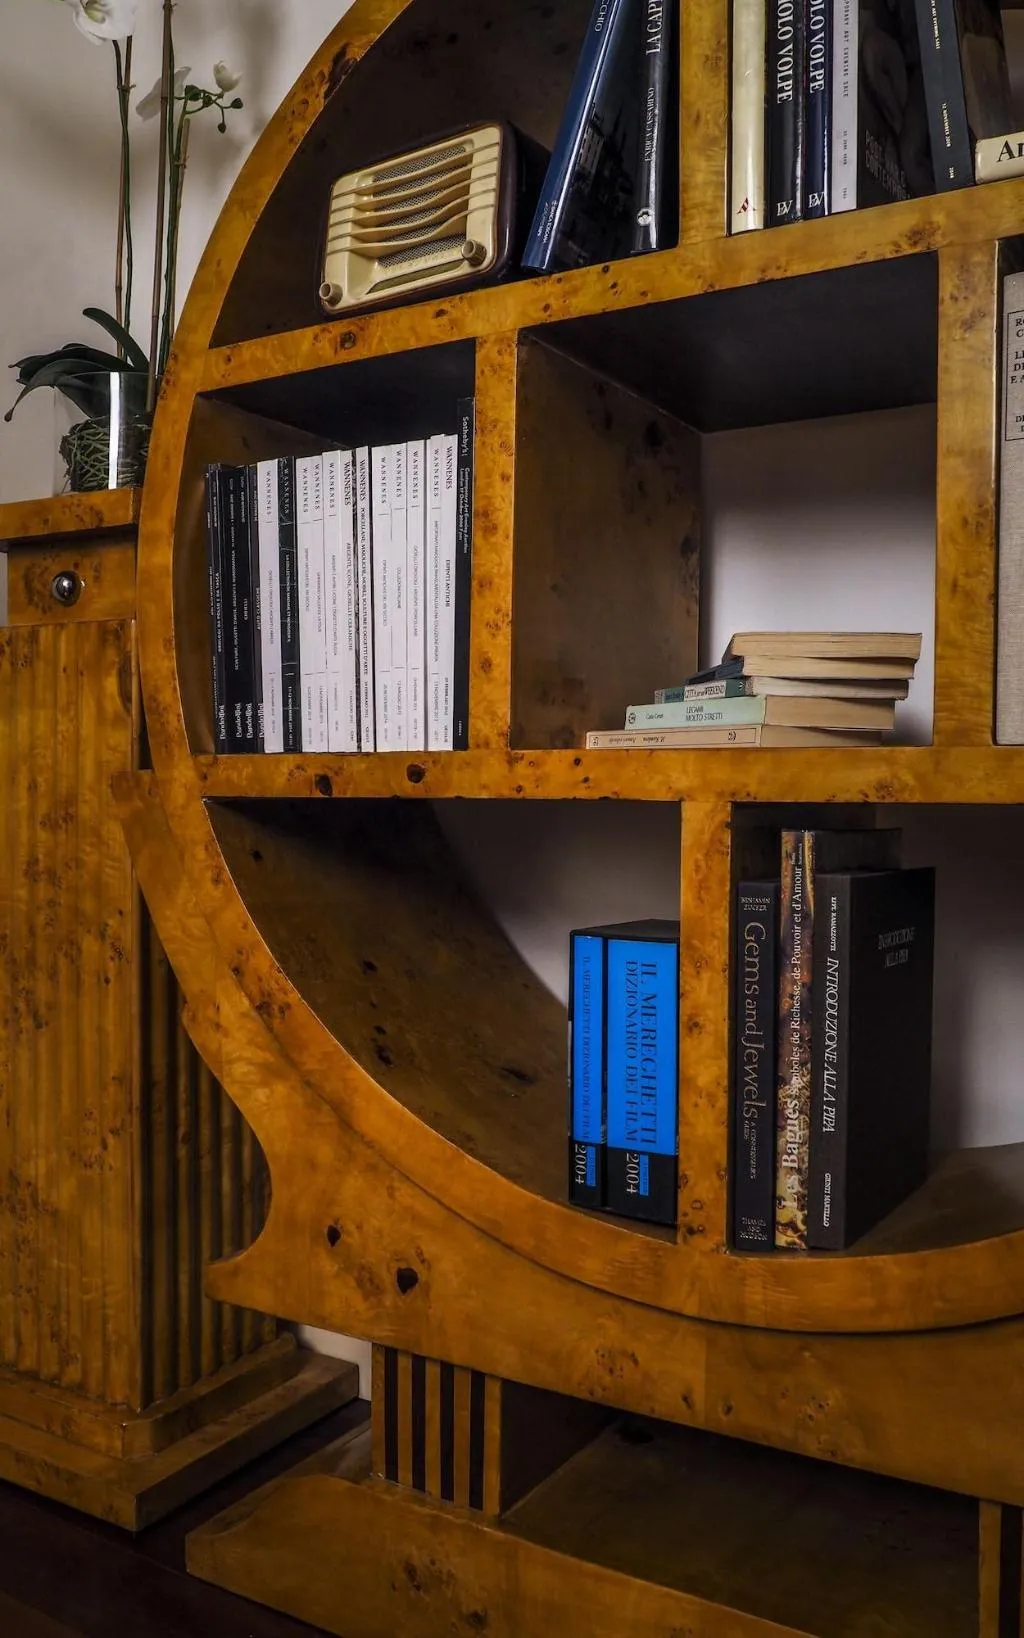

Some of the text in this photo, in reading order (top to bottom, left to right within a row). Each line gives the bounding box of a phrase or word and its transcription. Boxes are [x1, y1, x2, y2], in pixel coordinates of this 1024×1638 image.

[645, 35, 662, 55] LA
[809, 31, 825, 94] VOLPE
[776, 43, 793, 104] VOLPE
[461, 416, 470, 453] Sotheby's
[344, 461, 352, 506] WANNENES
[445, 445, 453, 490] WANNENES
[217, 704, 226, 740] Pandolfini
[233, 702, 243, 738] Pandolfini
[245, 702, 253, 739] Pandolfini
[790, 866, 803, 911] d'Amour
[792, 912, 802, 923] et
[790, 925, 802, 965] Pouvoir
[640, 961, 658, 984] IL
[790, 967, 801, 980] de
[741, 921, 767, 1119] Gems and Jewels
[790, 981, 803, 1030] Richesse,
[624, 959, 638, 1142] DIZIONARIO DEI FILM
[790, 1031, 801, 1045] de
[822, 957, 839, 1133] INTRODUZIONE ALLA PIPA
[582, 1036, 591, 1092] DIZIONARIO
[640, 991, 658, 1144] MEREGHETTI
[781, 1099, 803, 1169] Bagues
[574, 1143, 587, 1185] 2004
[626, 1152, 640, 1194] 2004
[823, 1194, 831, 1227] MARTELLO
